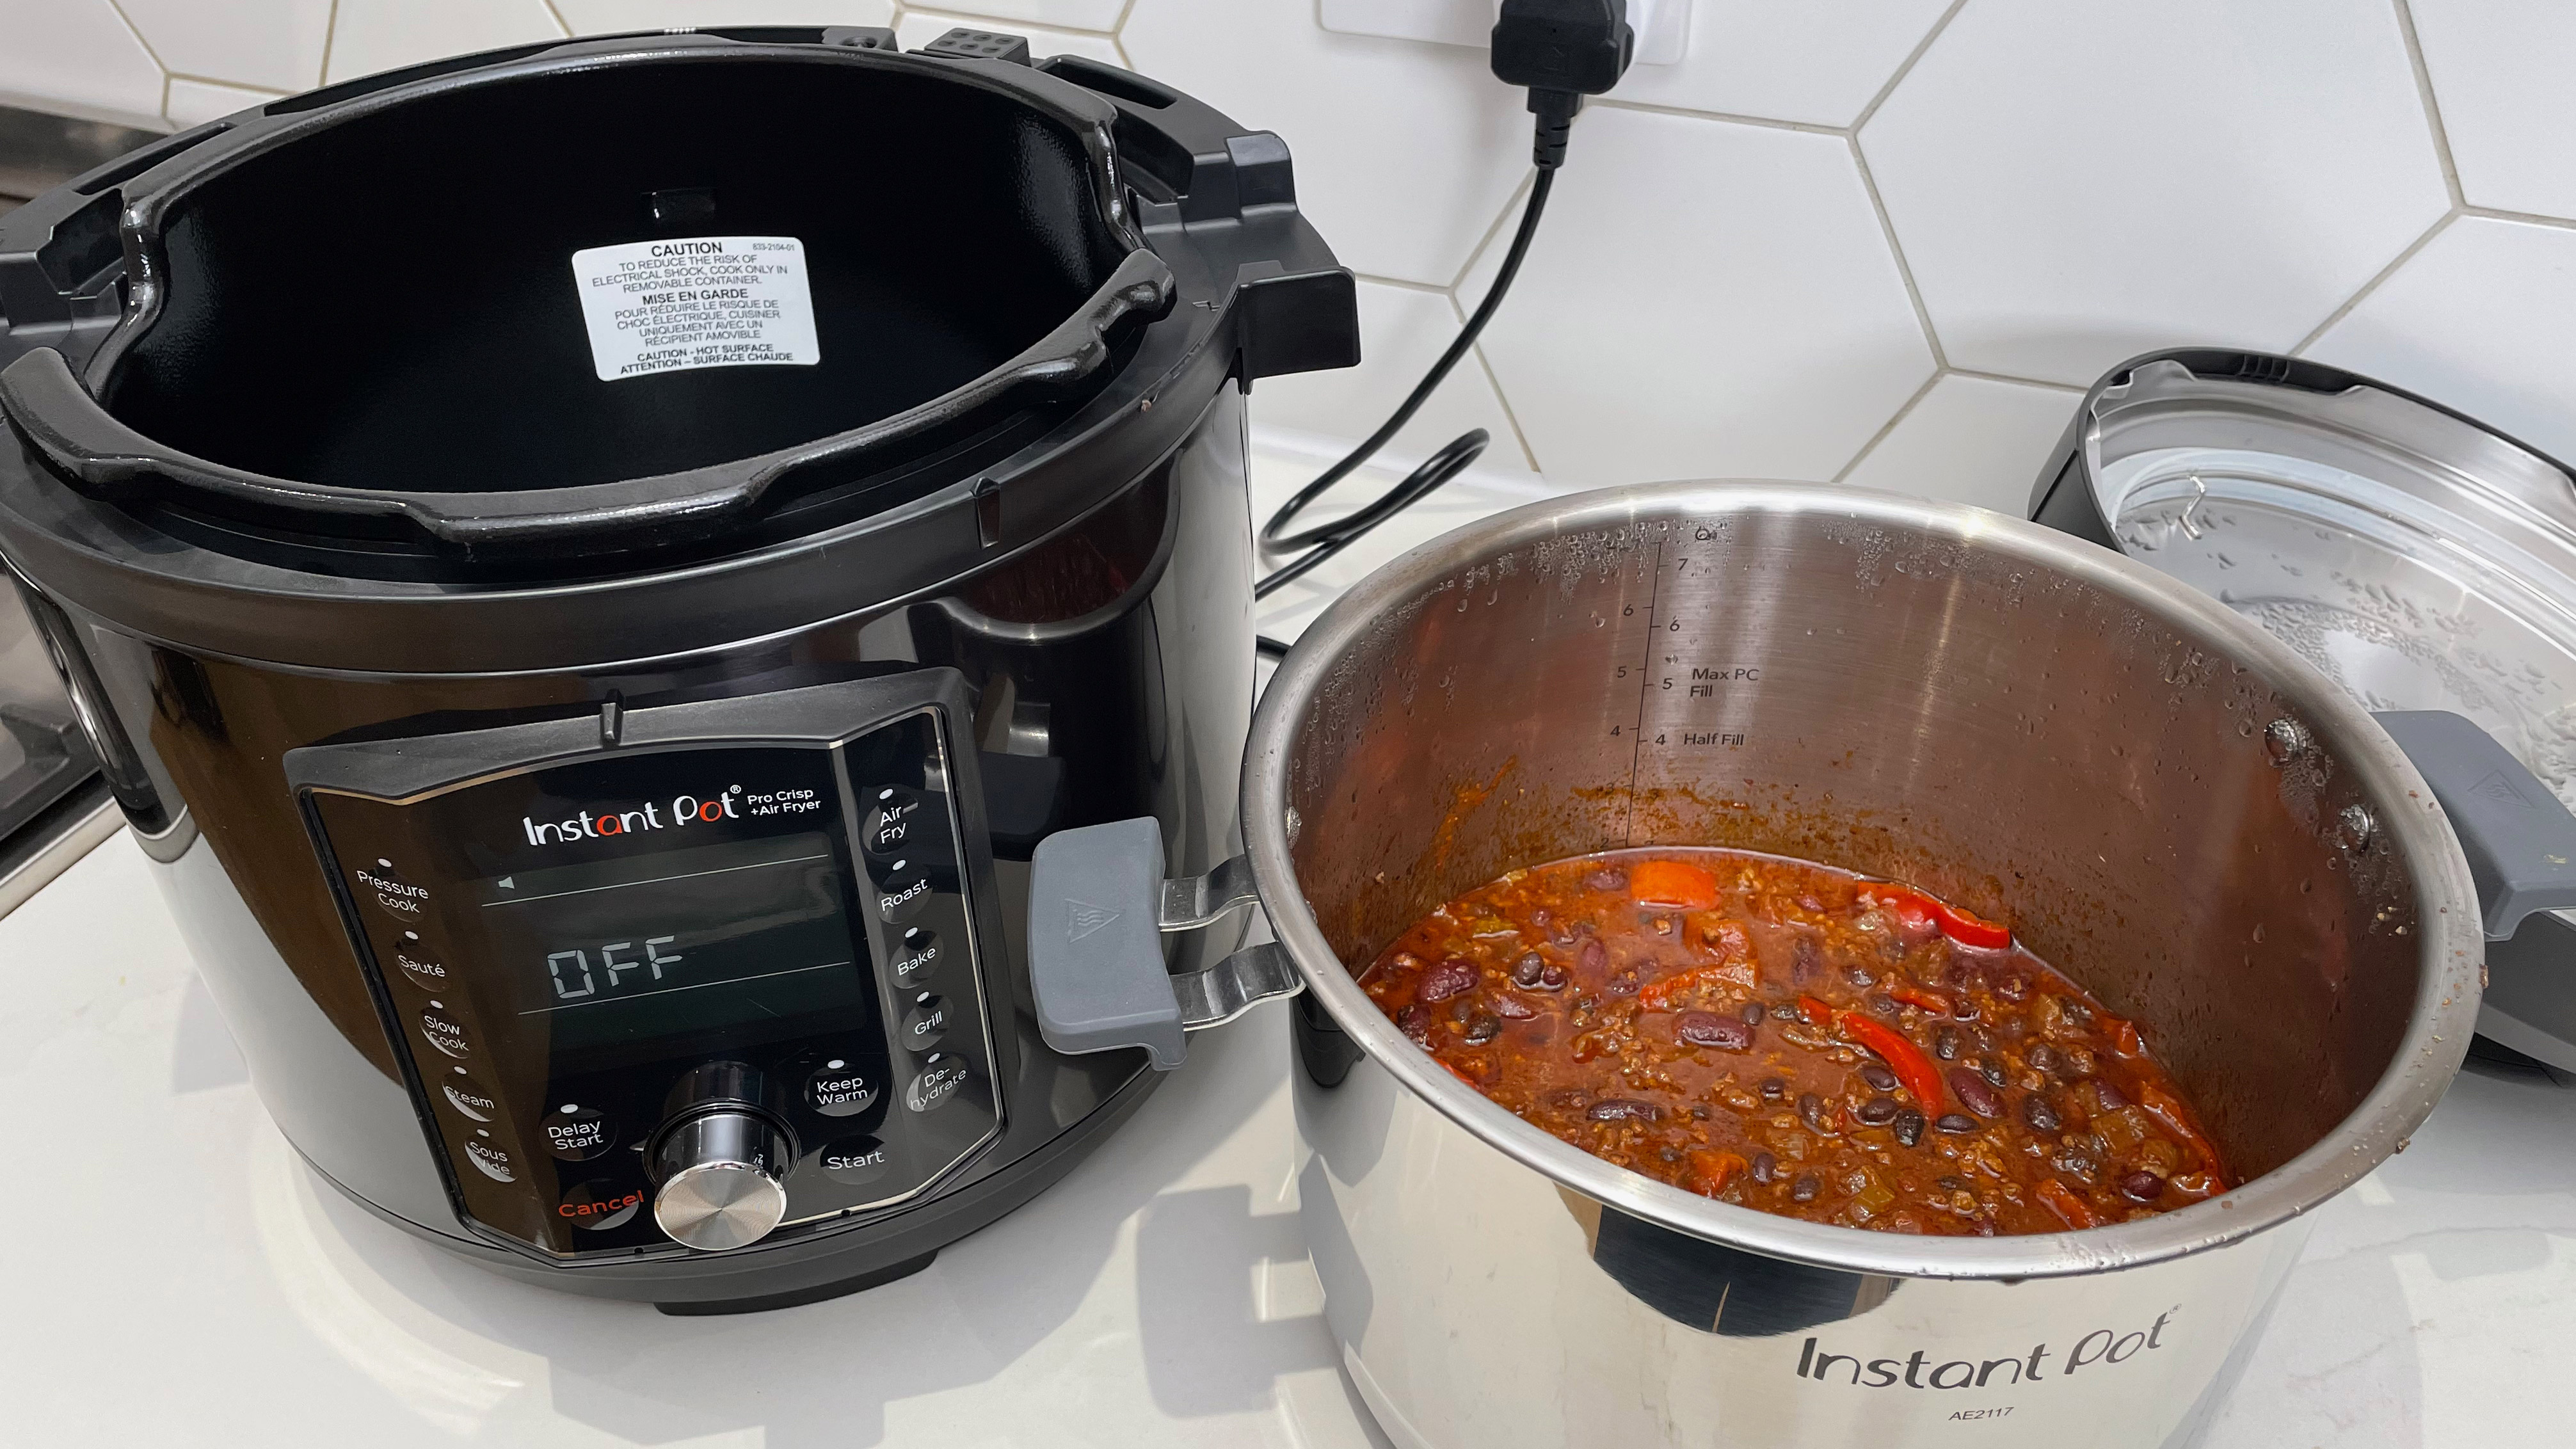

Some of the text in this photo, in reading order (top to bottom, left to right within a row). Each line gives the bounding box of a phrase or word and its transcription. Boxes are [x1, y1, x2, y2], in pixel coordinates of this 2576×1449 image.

[652, 241, 723, 257] CAUTION
[619, 254, 757, 271] TO REDUCE THE RISK OF
[592, 265, 787, 287] ELECTRICAL SHOCK, COOK ONLY IN
[623, 278, 692, 293] REMOVABLE
[643, 288, 749, 305] MISE EN GARDE
[615, 300, 779, 320] POUR RÉDUIRE LE RISQUE DE
[617, 317, 651, 330] CHOC
[729, 310, 780, 319] CUISINER
[639, 320, 762, 337] UNIQUEMENT AVEC UN
[645, 330, 761, 347] RÉCIPIENT AMOVIBLE
[637, 348, 687, 362] CAUTION
[696, 346, 719, 355] HOT
[721, 344, 774, 353] SURFACE
[620, 358, 682, 374] ATTENTION
[693, 353, 745, 365] SURFACE
[748, 352, 794, 361] CHAUDE
[1678, 558, 1688, 570] 7
[1623, 604, 1634, 616] 6
[1670, 619, 1680, 632] 6
[1617, 666, 1627, 678] 5
[1692, 668, 1759, 681] Max PC
[1662, 678, 1673, 689] 5
[1690, 685, 1713, 697] Fill
[1610, 726, 1621, 737] 4
[1655, 734, 1666, 745] 4
[1684, 733, 1744, 746] Half Fill
[748, 789, 814, 805] Pro Crisp
[751, 798, 821, 816] +Air Fryer
[880, 805, 905, 827] Air
[523, 802, 663, 845] Instant
[880, 822, 907, 844] Fry
[357, 870, 429, 899] Pressure
[378, 892, 420, 914] Cook
[881, 877, 928, 911] Roast
[398, 954, 445, 978] Sauté
[547, 935, 683, 999] OFF
[897, 947, 936, 976] Bake
[424, 1015, 460, 1036] Slow
[915, 1010, 943, 1035] Grill
[429, 1031, 469, 1052] Cook
[817, 1077, 863, 1094] Keep
[924, 1068, 950, 1087] De-
[445, 1085, 495, 1109] Steam
[817, 1087, 868, 1105] Warm
[548, 1121, 602, 1139] Delay
[555, 1132, 604, 1150] Start
[470, 1141, 508, 1162] Sous
[828, 1150, 885, 1170] Start
[558, 1190, 644, 1217] Cancel
[1796, 1337, 2051, 1389] Instant
[1948, 1406, 2014, 1421] AE2117
